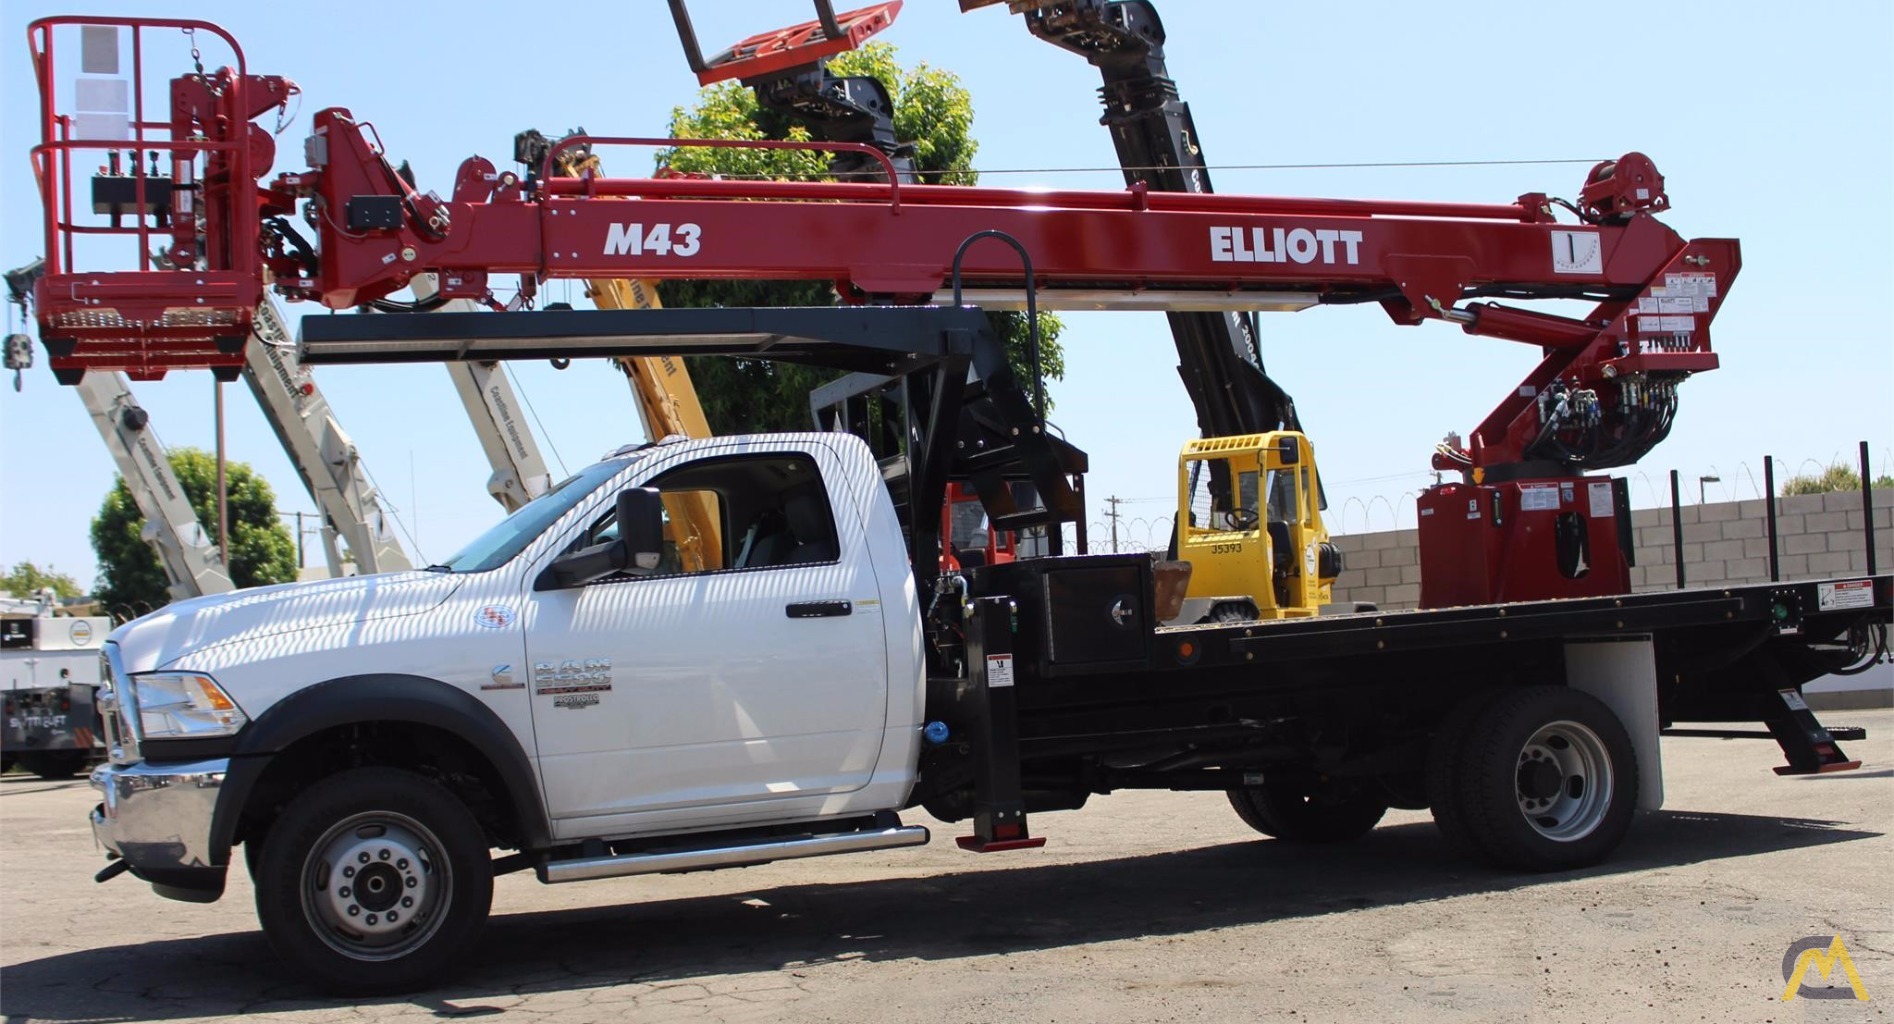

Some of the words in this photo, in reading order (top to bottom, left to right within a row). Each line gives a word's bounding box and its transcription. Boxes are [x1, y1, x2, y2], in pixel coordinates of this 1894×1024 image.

[603, 223, 702, 257] M43
[1209, 226, 1363, 265] ELLIOTT
[1211, 543, 1243, 555] 35393
